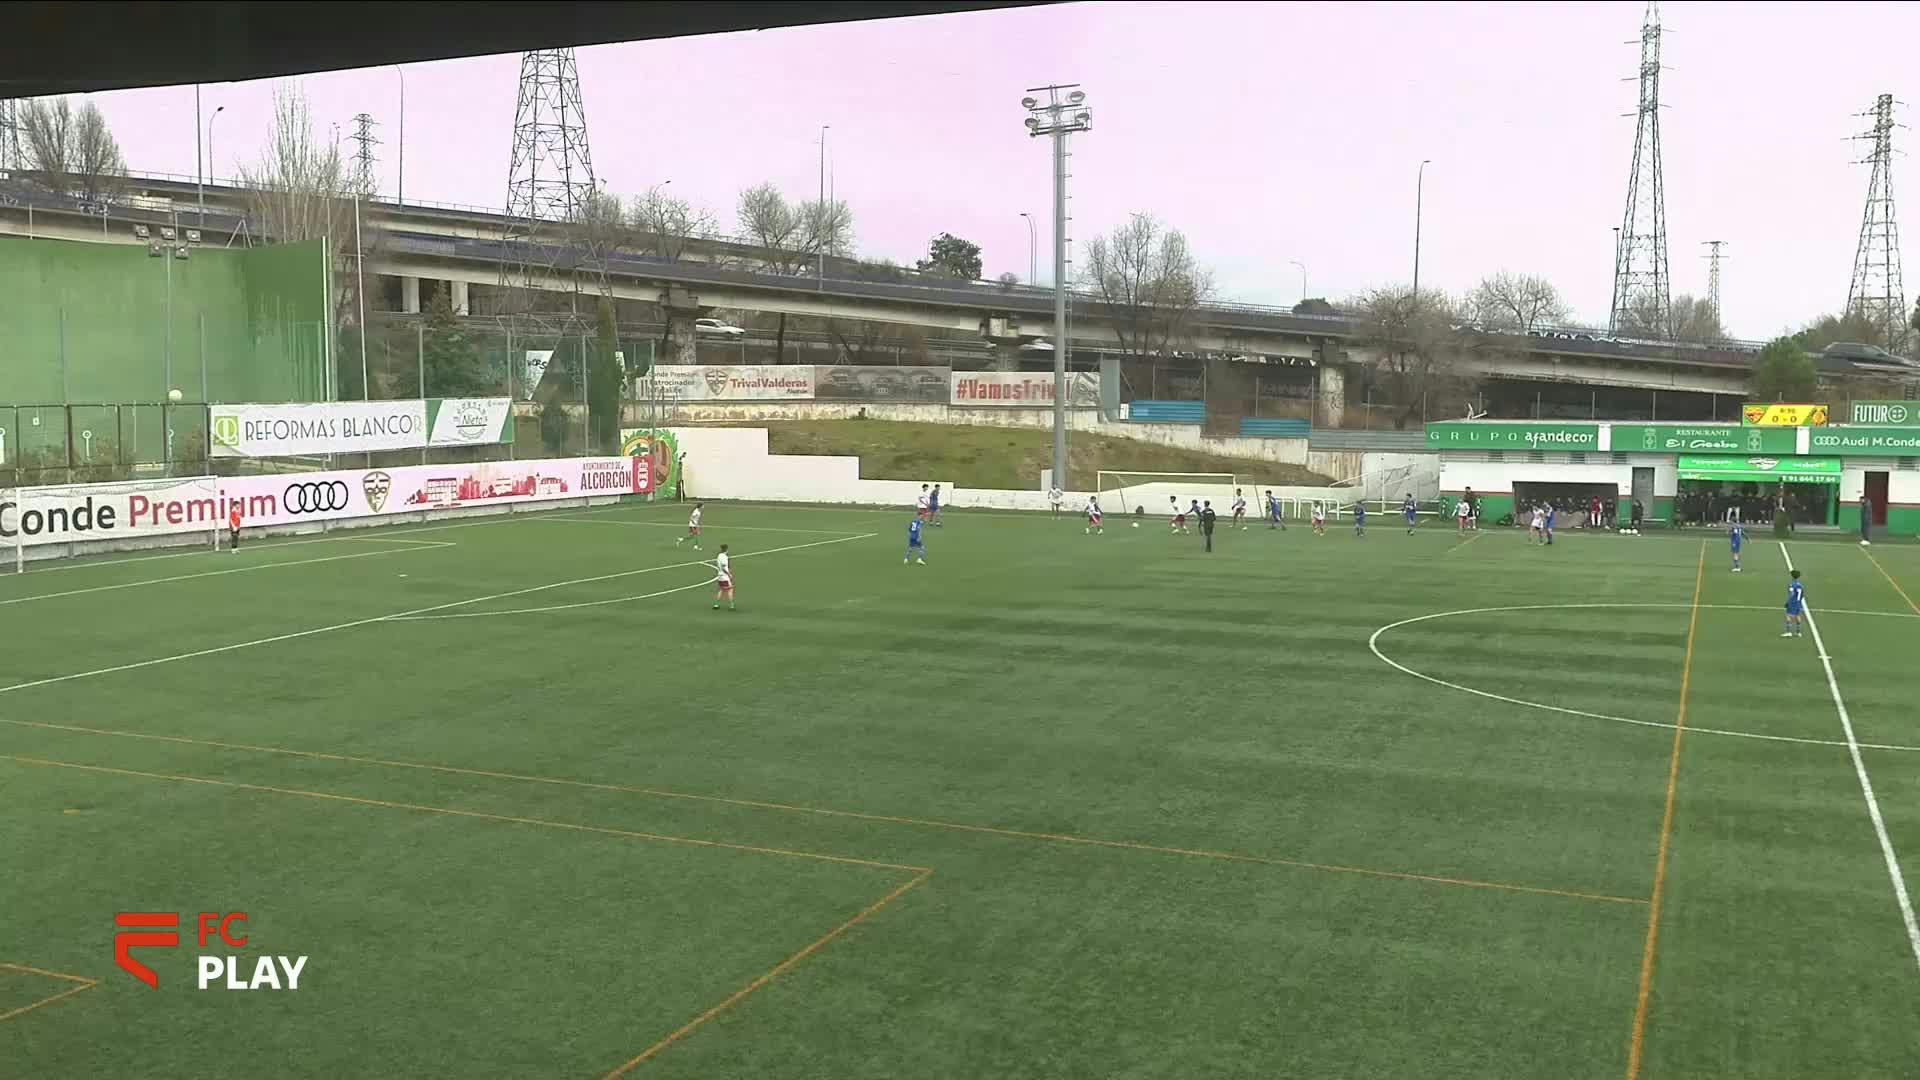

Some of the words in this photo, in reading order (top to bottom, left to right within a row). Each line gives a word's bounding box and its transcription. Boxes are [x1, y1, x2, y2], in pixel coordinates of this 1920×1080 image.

[957, 379, 1070, 400] #VamosTrivl
[1772, 415, 1779, 423] 0
[1790, 415, 1797, 423] 0
[245, 419, 336, 440] REFORMAS
[1676, 429, 1731, 437] RESTAURANTE
[1430, 431, 1518, 441] GRUPO
[1525, 431, 1594, 448] afandecor
[1665, 439, 1686, 448] El
[1842, 437, 1869, 447] Audi
[581, 466, 632, 490] ALCORCÓN
[0, 496, 116, 537] Conde
